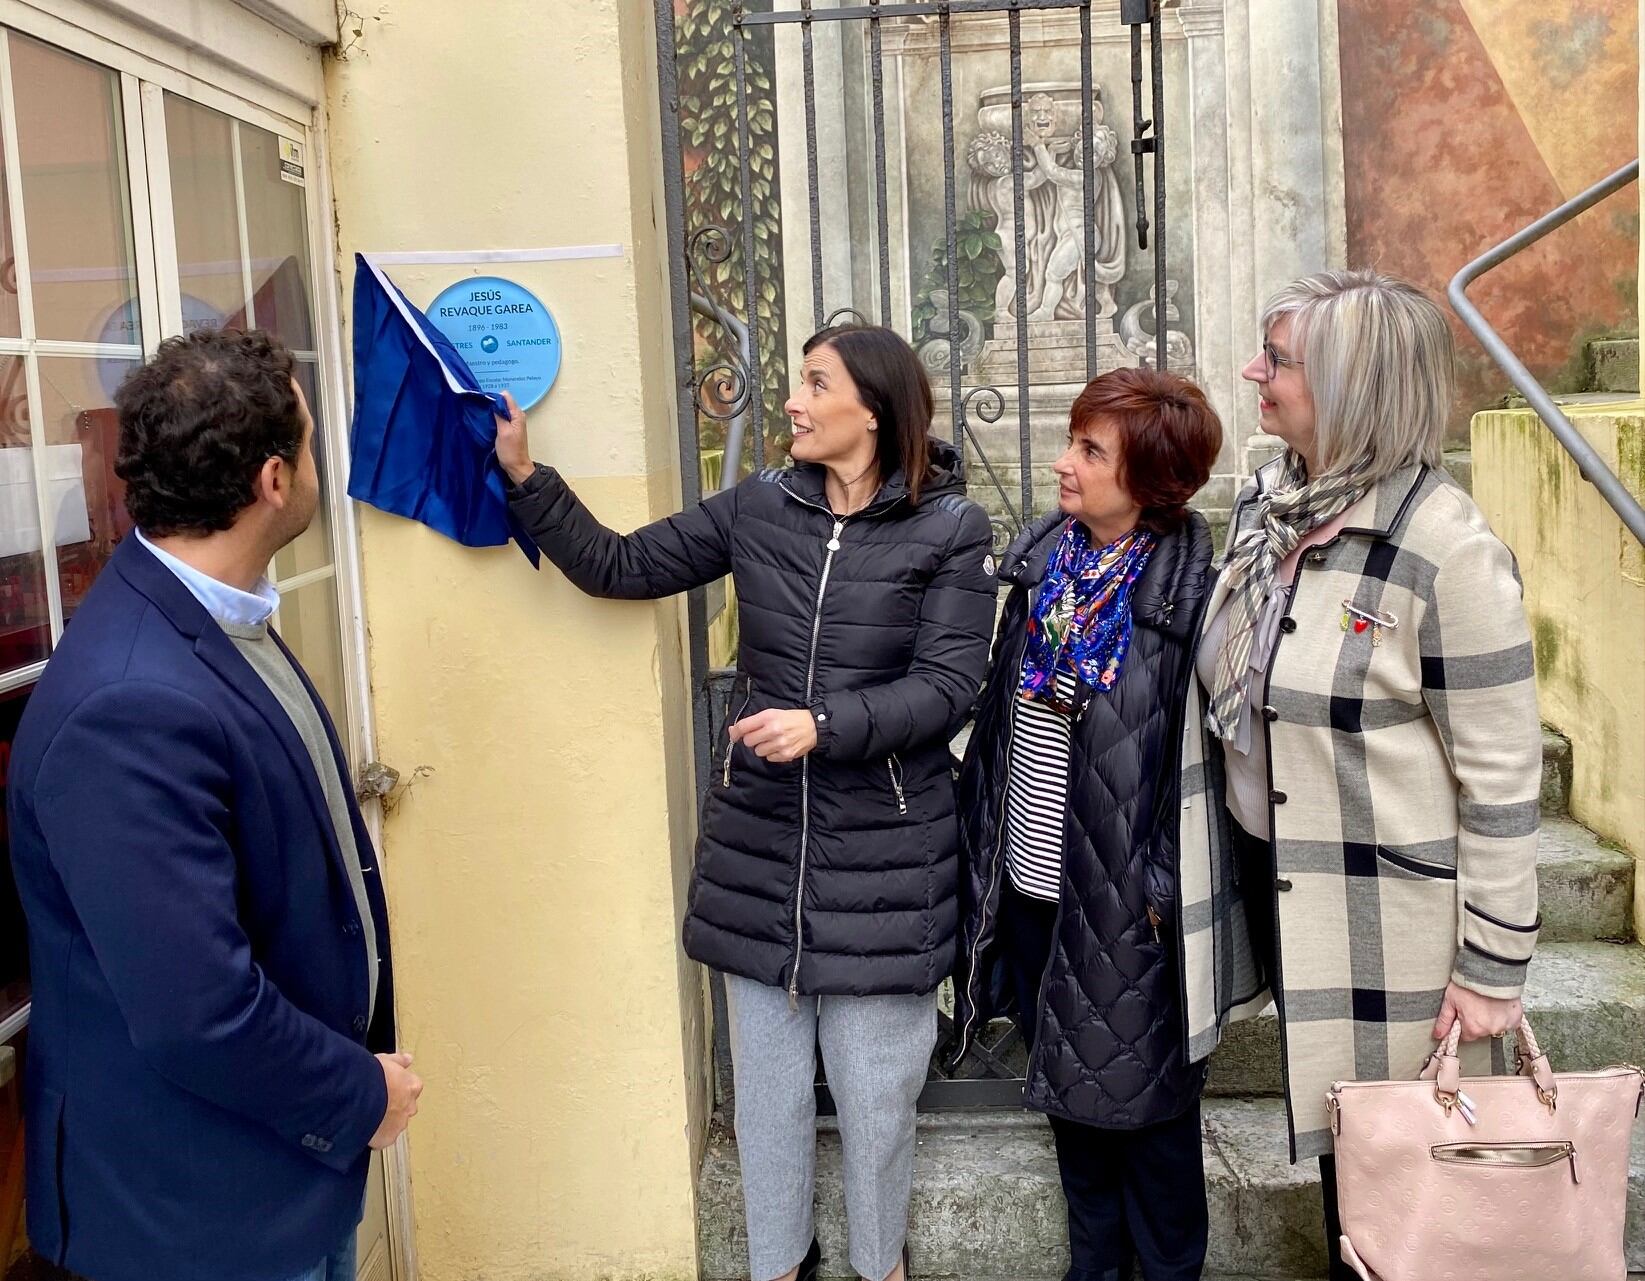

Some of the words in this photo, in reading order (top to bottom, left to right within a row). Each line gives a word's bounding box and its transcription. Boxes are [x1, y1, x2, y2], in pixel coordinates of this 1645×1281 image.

[469, 289, 501, 302] JESÚS
[440, 305, 493, 317] REVAQUE
[495, 303, 533, 315] GAREA
[468, 324, 485, 332] 1896
[491, 323, 508, 331] 1983
[506, 338, 551, 347] SANTANDER
